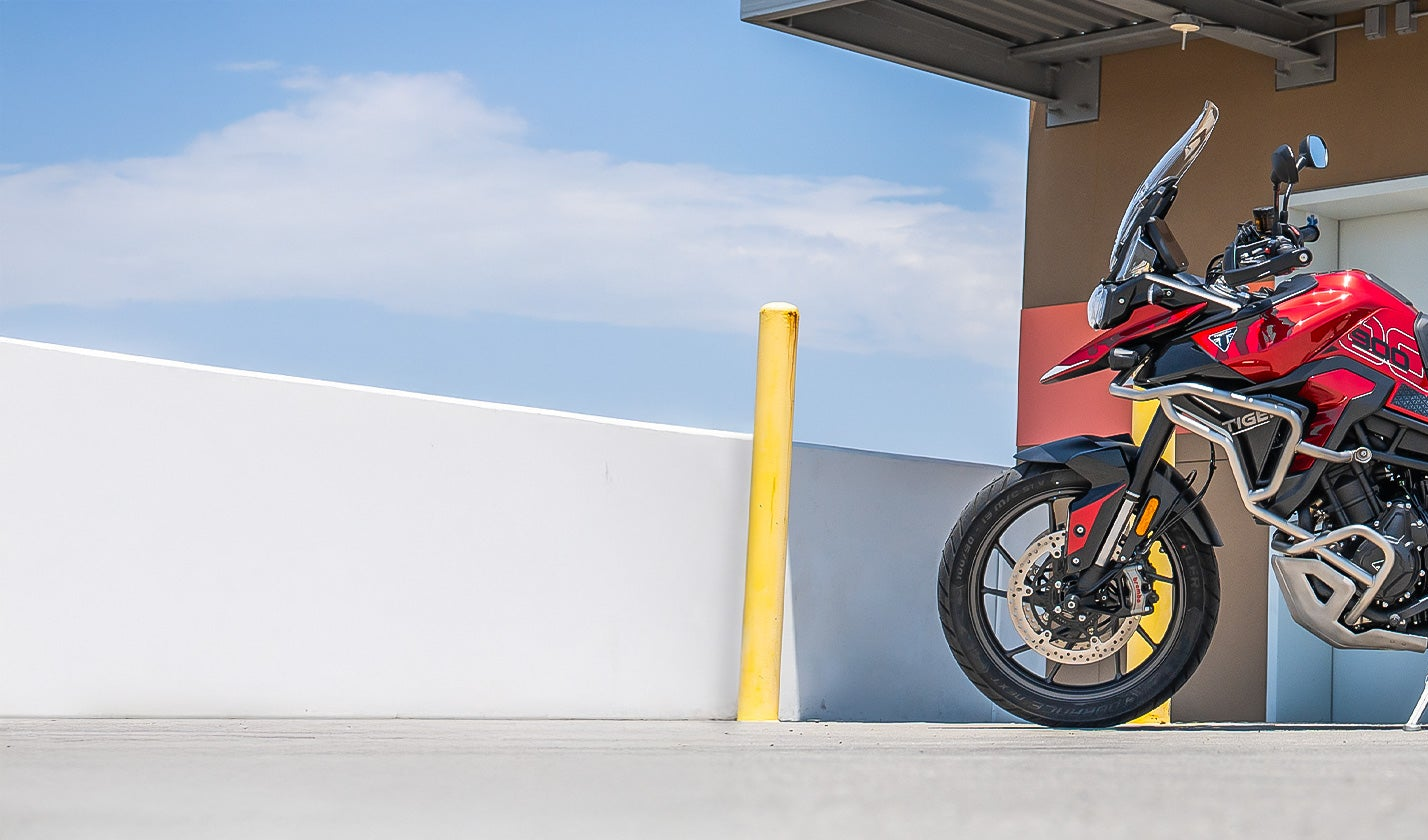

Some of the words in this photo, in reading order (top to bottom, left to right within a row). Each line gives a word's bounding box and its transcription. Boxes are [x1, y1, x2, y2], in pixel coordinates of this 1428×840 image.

[1351, 328, 1409, 371] 900
[1221, 411, 1274, 433] TIGE
[1132, 576, 1142, 604] brembo
